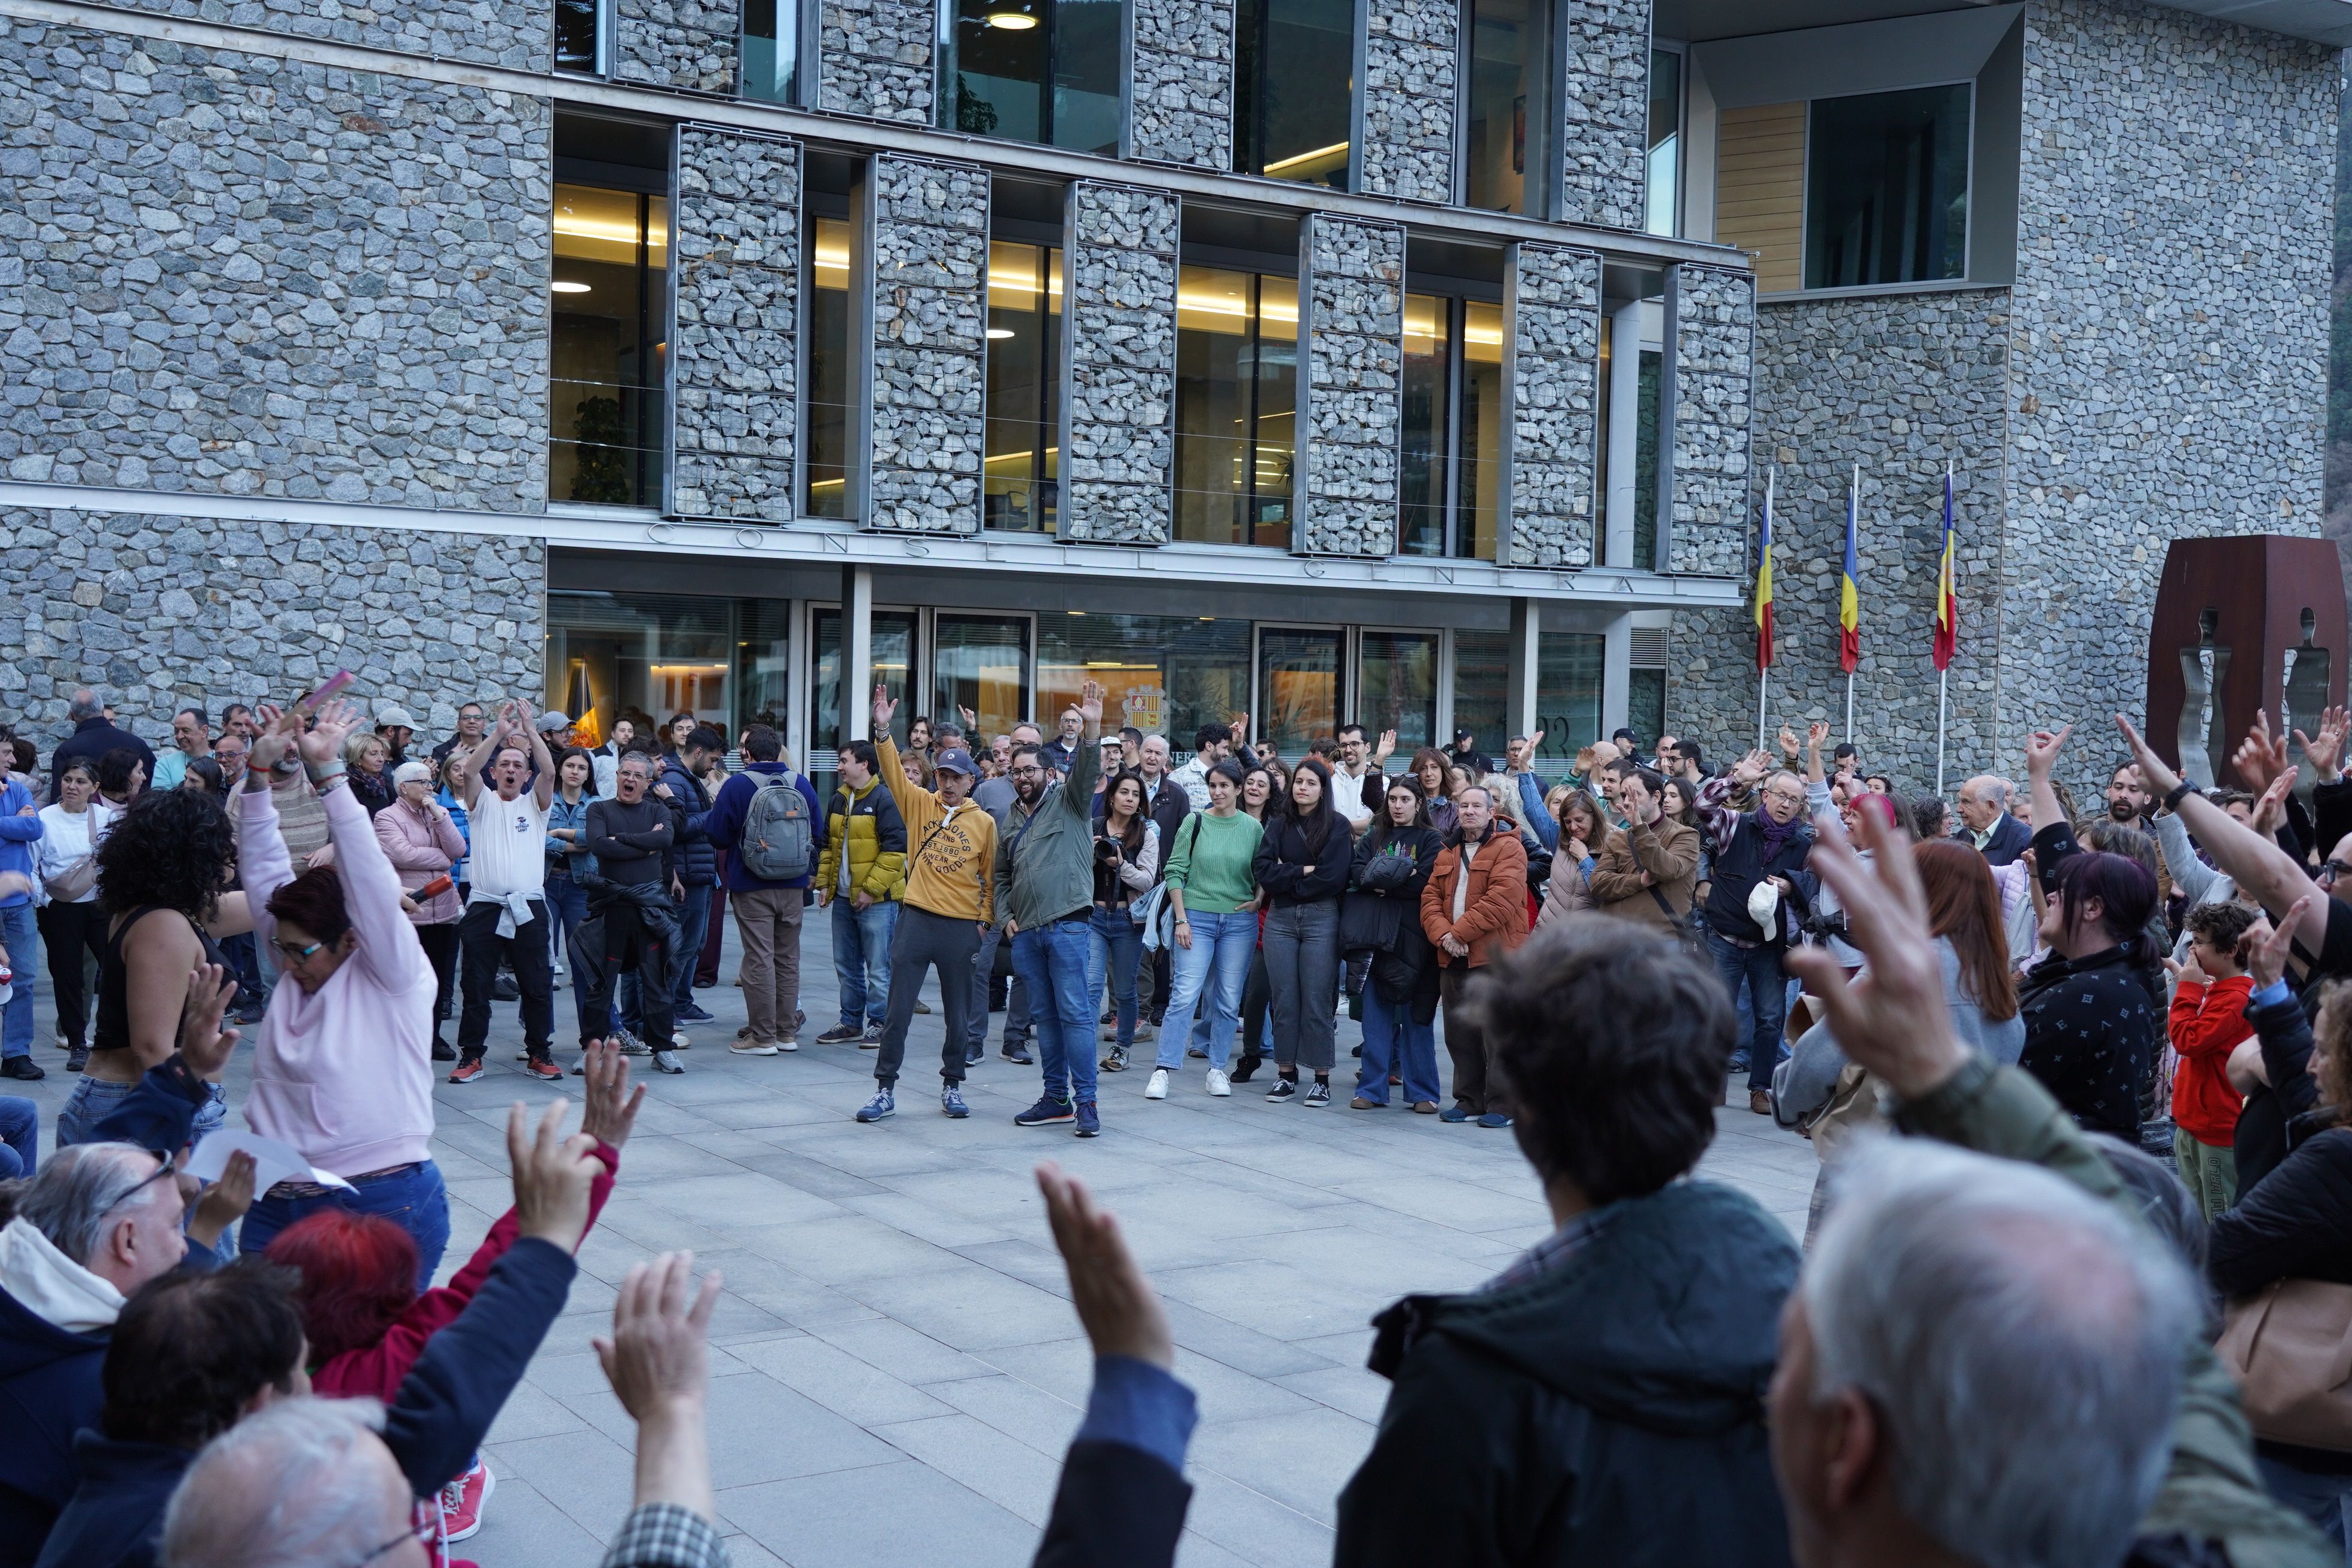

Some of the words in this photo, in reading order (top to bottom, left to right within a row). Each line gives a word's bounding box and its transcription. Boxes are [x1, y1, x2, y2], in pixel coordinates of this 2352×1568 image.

[647, 523, 1156, 569] CONSELL
[1303, 560, 1688, 596] GENERAL
[936, 832, 955, 843] EANS
[928, 853, 949, 864] WEAR
[936, 856, 967, 874] GOODS
